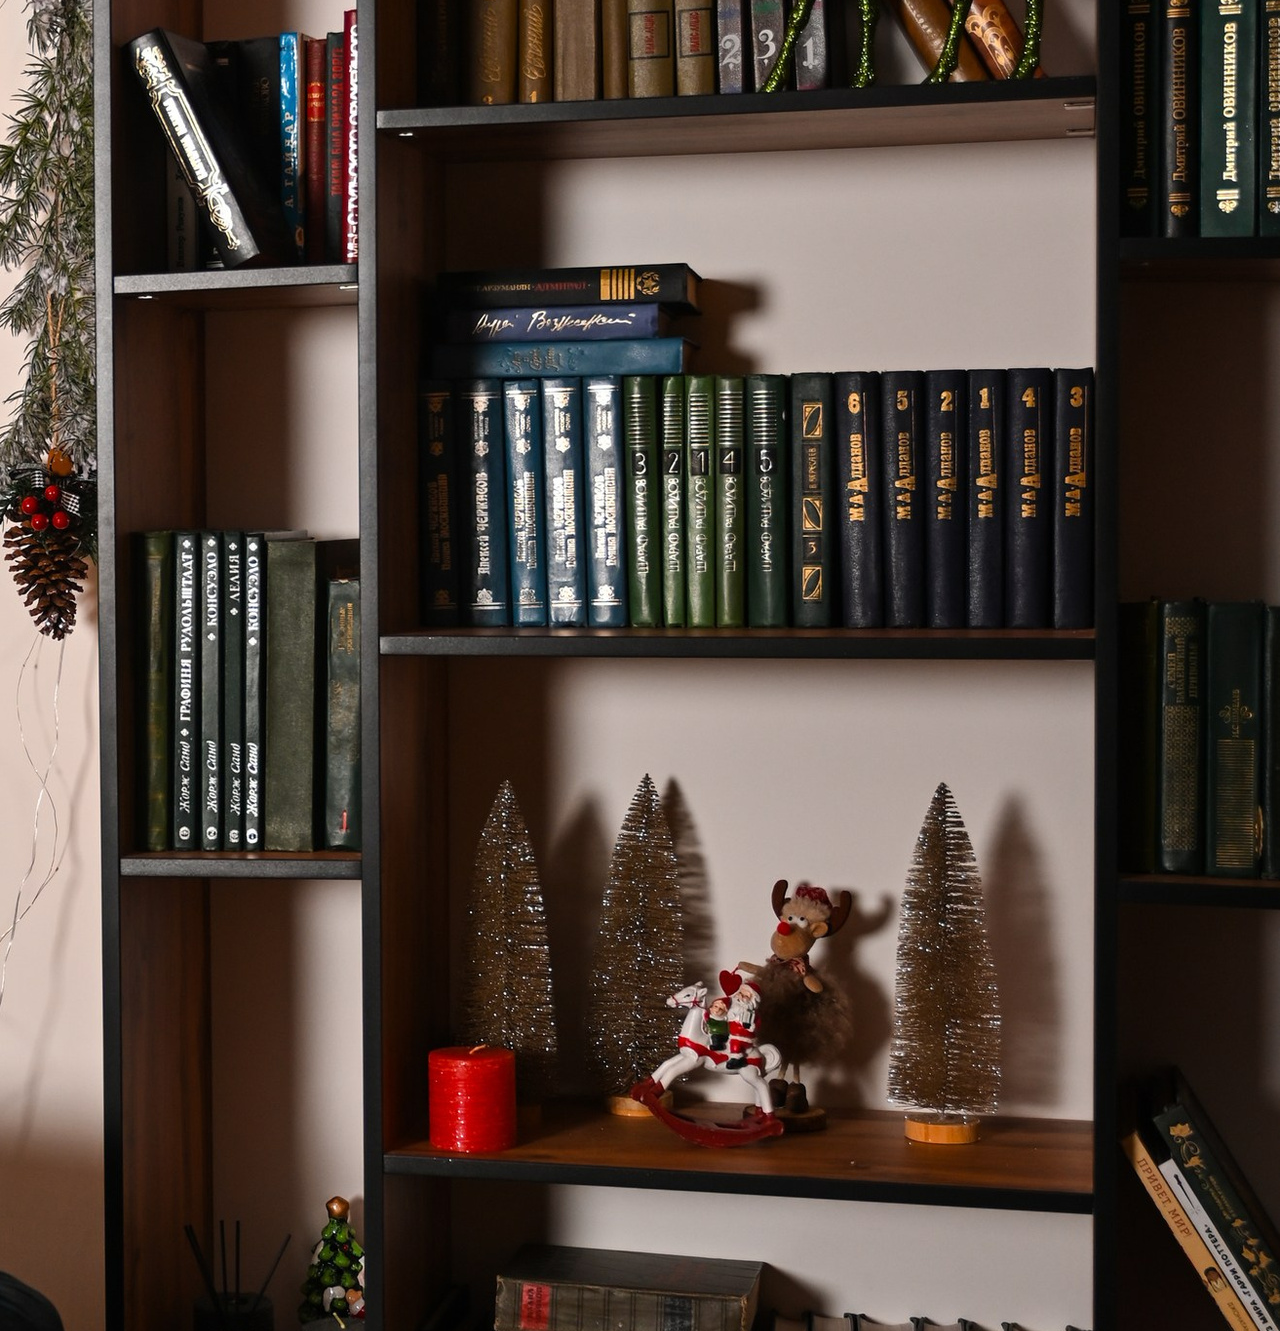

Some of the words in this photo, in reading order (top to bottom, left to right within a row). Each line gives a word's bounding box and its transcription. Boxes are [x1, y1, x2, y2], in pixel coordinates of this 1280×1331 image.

[330, 47, 343, 79] ЗОРГЕ
[721, 35, 740, 67] 2
[758, 30, 776, 61] 3
[802, 38, 814, 69] 1
[1173, 27, 1185, 120] ОВИННИКОВ
[1222, 21, 1238, 118] ОВИННИКОВ
[283, 112, 295, 187] ГАЙДАР
[330, 131, 342, 154] БЫЛ
[1173, 124, 1187, 182] Дмитрий
[1223, 121, 1239, 183] Дмитрий
[330, 159, 342, 196] ТАКИМ
[284, 194, 293, 209] А.
[848, 393, 860, 414] 6
[897, 391, 908, 411] 5
[941, 391, 953, 412] 2
[979, 388, 990, 410] 1
[1021, 388, 1036, 409] 4
[1070, 387, 1083, 408] 3
[634, 453, 646, 475] 3
[668, 453, 678, 473] 2
[697, 452, 705, 473] 1
[722, 451, 734, 473] 4
[760, 449, 772, 473] 5
[475, 473, 489, 532] ЧЕРКАСОВ
[594, 476, 604, 525] ЧЕРКАСОВ
[635, 479, 647, 530] РАШИДОВ
[667, 478, 680, 529] РАШИДОВ
[695, 478, 707, 529] РАШИДОВ
[724, 477, 737, 527] РАШИДОВ
[760, 477, 773, 528] РАШИДОВ
[477, 535, 490, 575] Алексей
[637, 535, 648, 574] ШАРАФ
[668, 533, 679, 572] ШАРАФ
[696, 535, 706, 573] ШАРАФ
[725, 533, 736, 572] ШАРАФ
[760, 533, 771, 572] ШАРАФ
[206, 553, 218, 627] КОНСУЭЛО
[229, 555, 240, 603] ЛЕЛИЯ
[247, 557, 259, 631] КОНСУЭЛО
[180, 552, 193, 652] РУДОЛЬШТАДТ
[1175, 636, 1185, 704] БАБАЕВСКИЙ
[180, 659, 191, 722] ГРАФИНЯ
[179, 741, 191, 772] Санд
[205, 740, 217, 773] Санд
[229, 743, 241, 774] Санд
[247, 742, 259, 775] Санд
[180, 775, 191, 813] Жорж
[206, 774, 218, 813] Жорж
[229, 777, 241, 816] Жорж
[247, 777, 259, 817] Жорж
[1167, 1206, 1192, 1239] МИР!
[1248, 1299, 1268, 1325] МИРА
